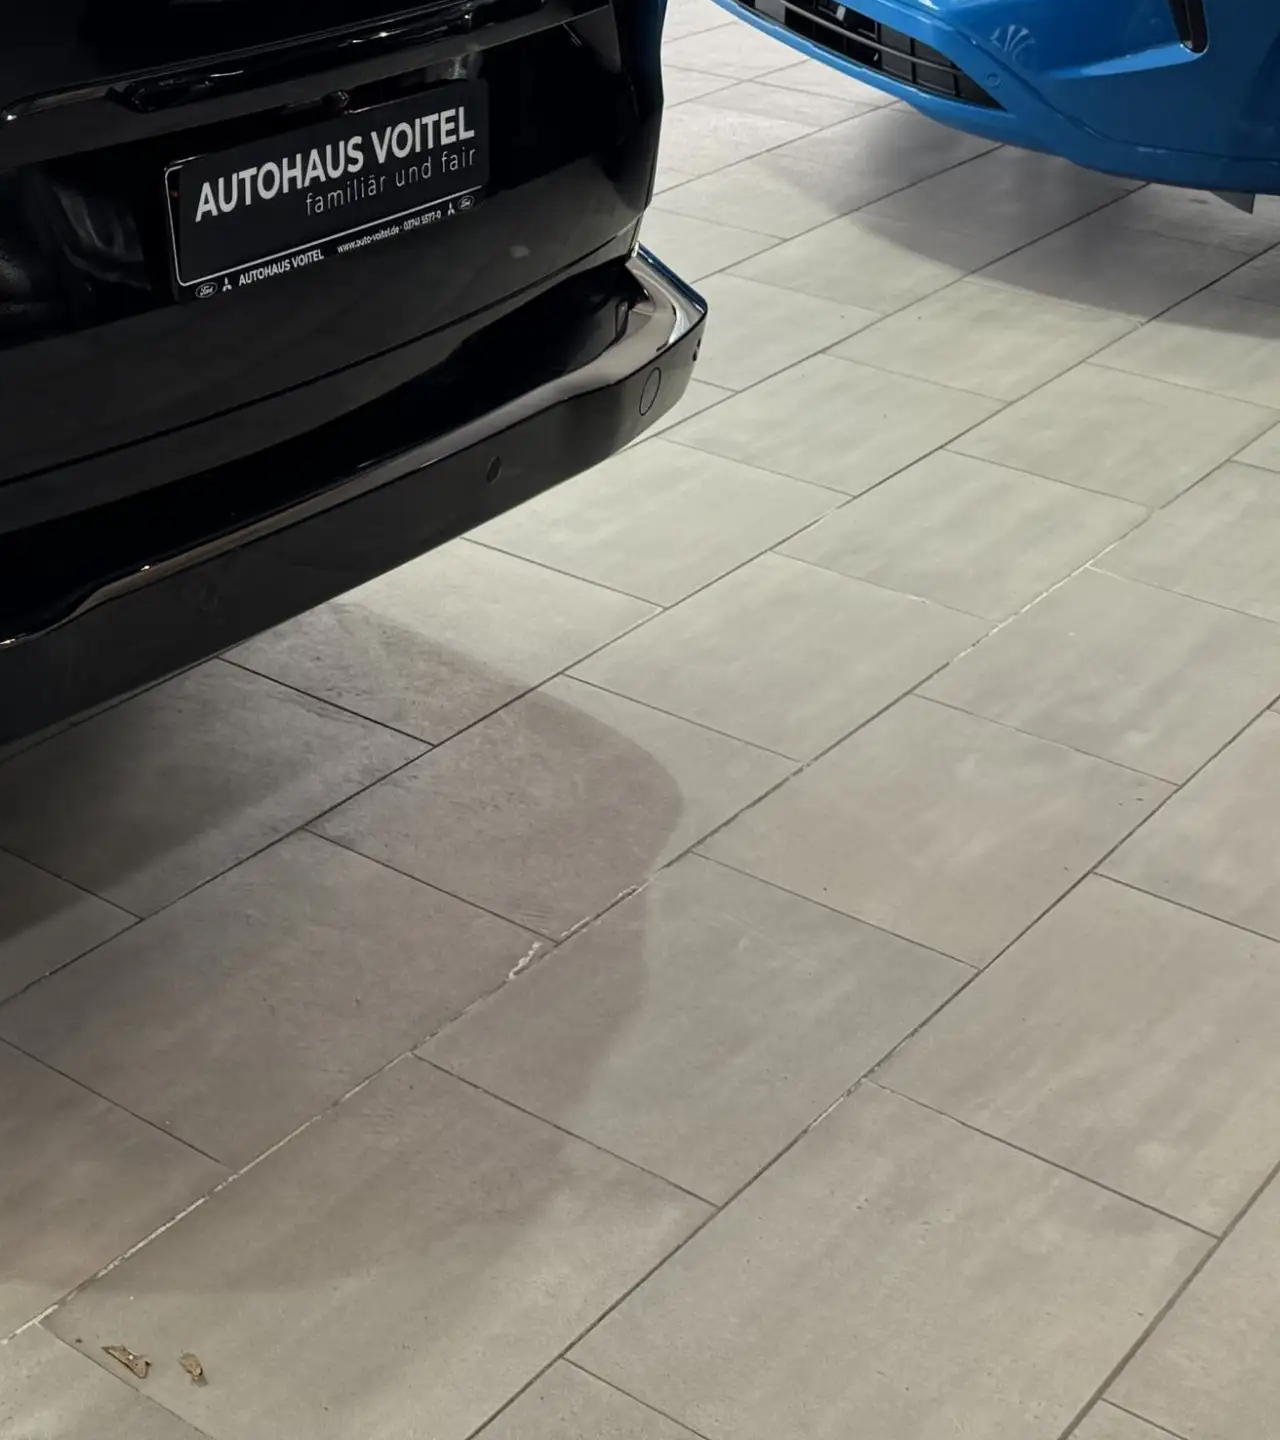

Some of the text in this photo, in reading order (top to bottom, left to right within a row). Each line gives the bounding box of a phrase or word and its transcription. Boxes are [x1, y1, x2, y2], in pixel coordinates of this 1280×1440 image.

[195, 106, 476, 223] AUTOHAUS VOITEL
[304, 146, 477, 216] familiär und fair
[238, 258, 291, 287] AUTOHAUS
[291, 248, 325, 271] VOITEL
[337, 224, 400, 254] www.auto-voitel.de
